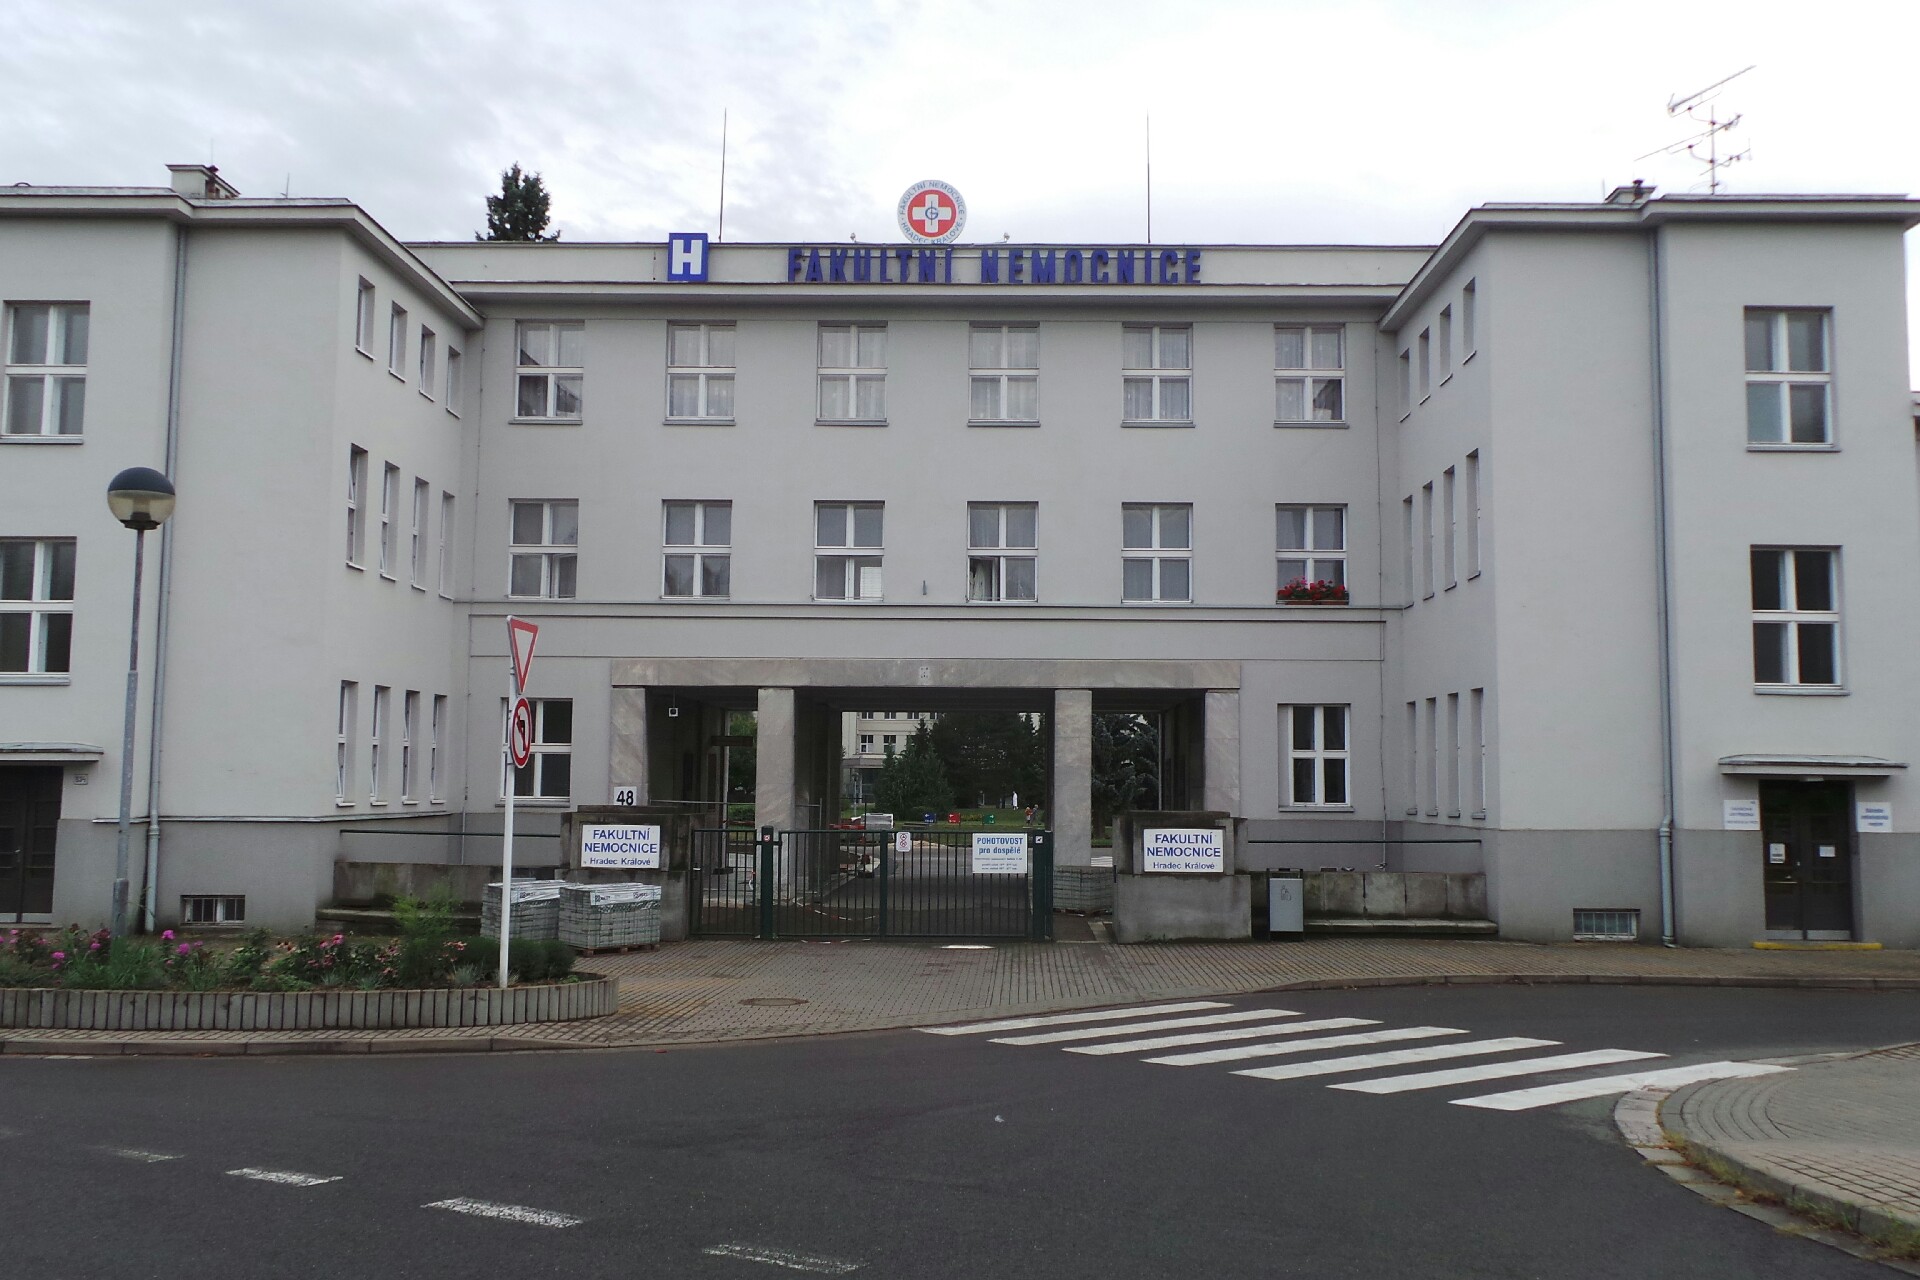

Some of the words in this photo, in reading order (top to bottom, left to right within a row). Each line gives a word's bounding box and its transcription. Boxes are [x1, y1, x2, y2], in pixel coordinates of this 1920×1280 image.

[928, 182, 965, 215] NEMOCNICE
[672, 239, 702, 275] H
[981, 248, 1201, 284] NEMOCNICE
[616, 790, 634, 806] 48
[593, 828, 651, 840] FAKULTNÍ
[1155, 832, 1213, 844] FAKULTNÍ
[977, 837, 1024, 845] POHOTOVOST
[584, 843, 658, 853] NEMOCNICE
[993, 847, 1021, 856] dospělé
[1147, 847, 1221, 857] NEMOCNICE
[589, 857, 618, 865] Hradec
[621, 858, 651, 866] Králové
[1184, 862, 1215, 870] Králové
